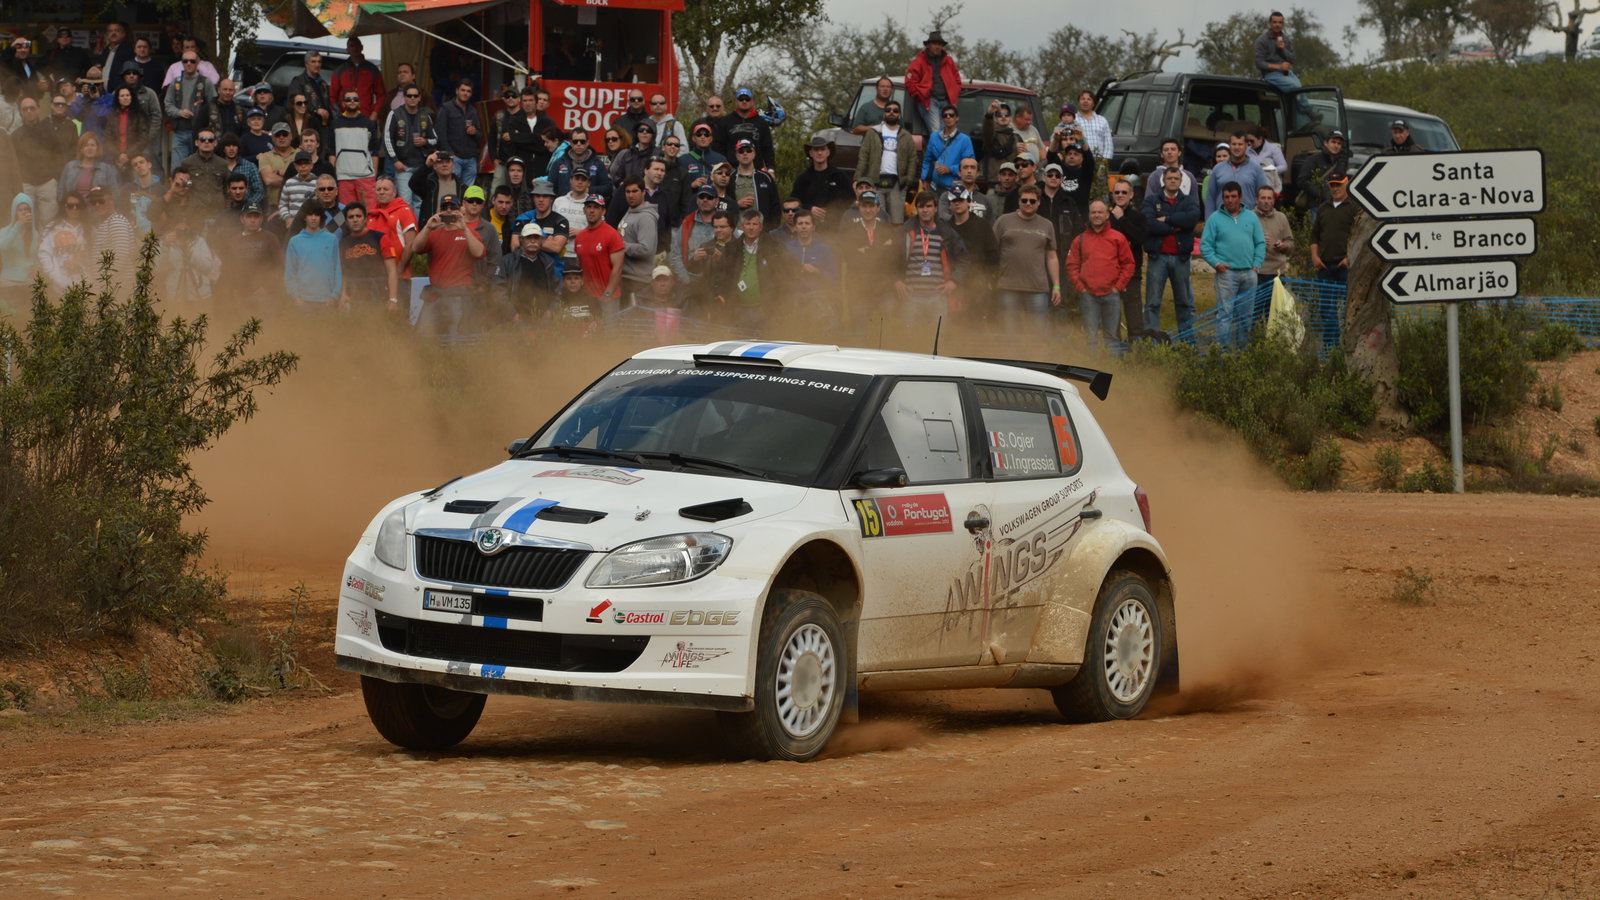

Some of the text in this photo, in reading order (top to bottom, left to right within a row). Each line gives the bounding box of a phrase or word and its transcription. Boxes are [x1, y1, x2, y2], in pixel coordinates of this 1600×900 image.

[562, 86, 630, 110] SUPE
[563, 109, 628, 132] BOC
[1432, 162, 1494, 181] Santa
[1392, 186, 1535, 208] Clara-a-Nova
[1453, 230, 1527, 248] Branco
[1414, 270, 1509, 293] Almarjão
[610, 369, 675, 377] VOLKSWAGEN
[713, 371, 767, 381] SUPPORTS
[768, 376, 807, 386] WINGS
[807, 381, 831, 390] FOR
[832, 385, 856, 395] LIFE
[1008, 432, 1035, 452] Ogier
[1051, 416, 1077, 467] 15
[856, 500, 880, 536] 15
[903, 506, 949, 520] Portugal
[999, 478, 1084, 536] VOLKSWAGEN GROUP SUPPORTS
[430, 594, 436, 606] H
[626, 611, 742, 625] Castrol EDGE
